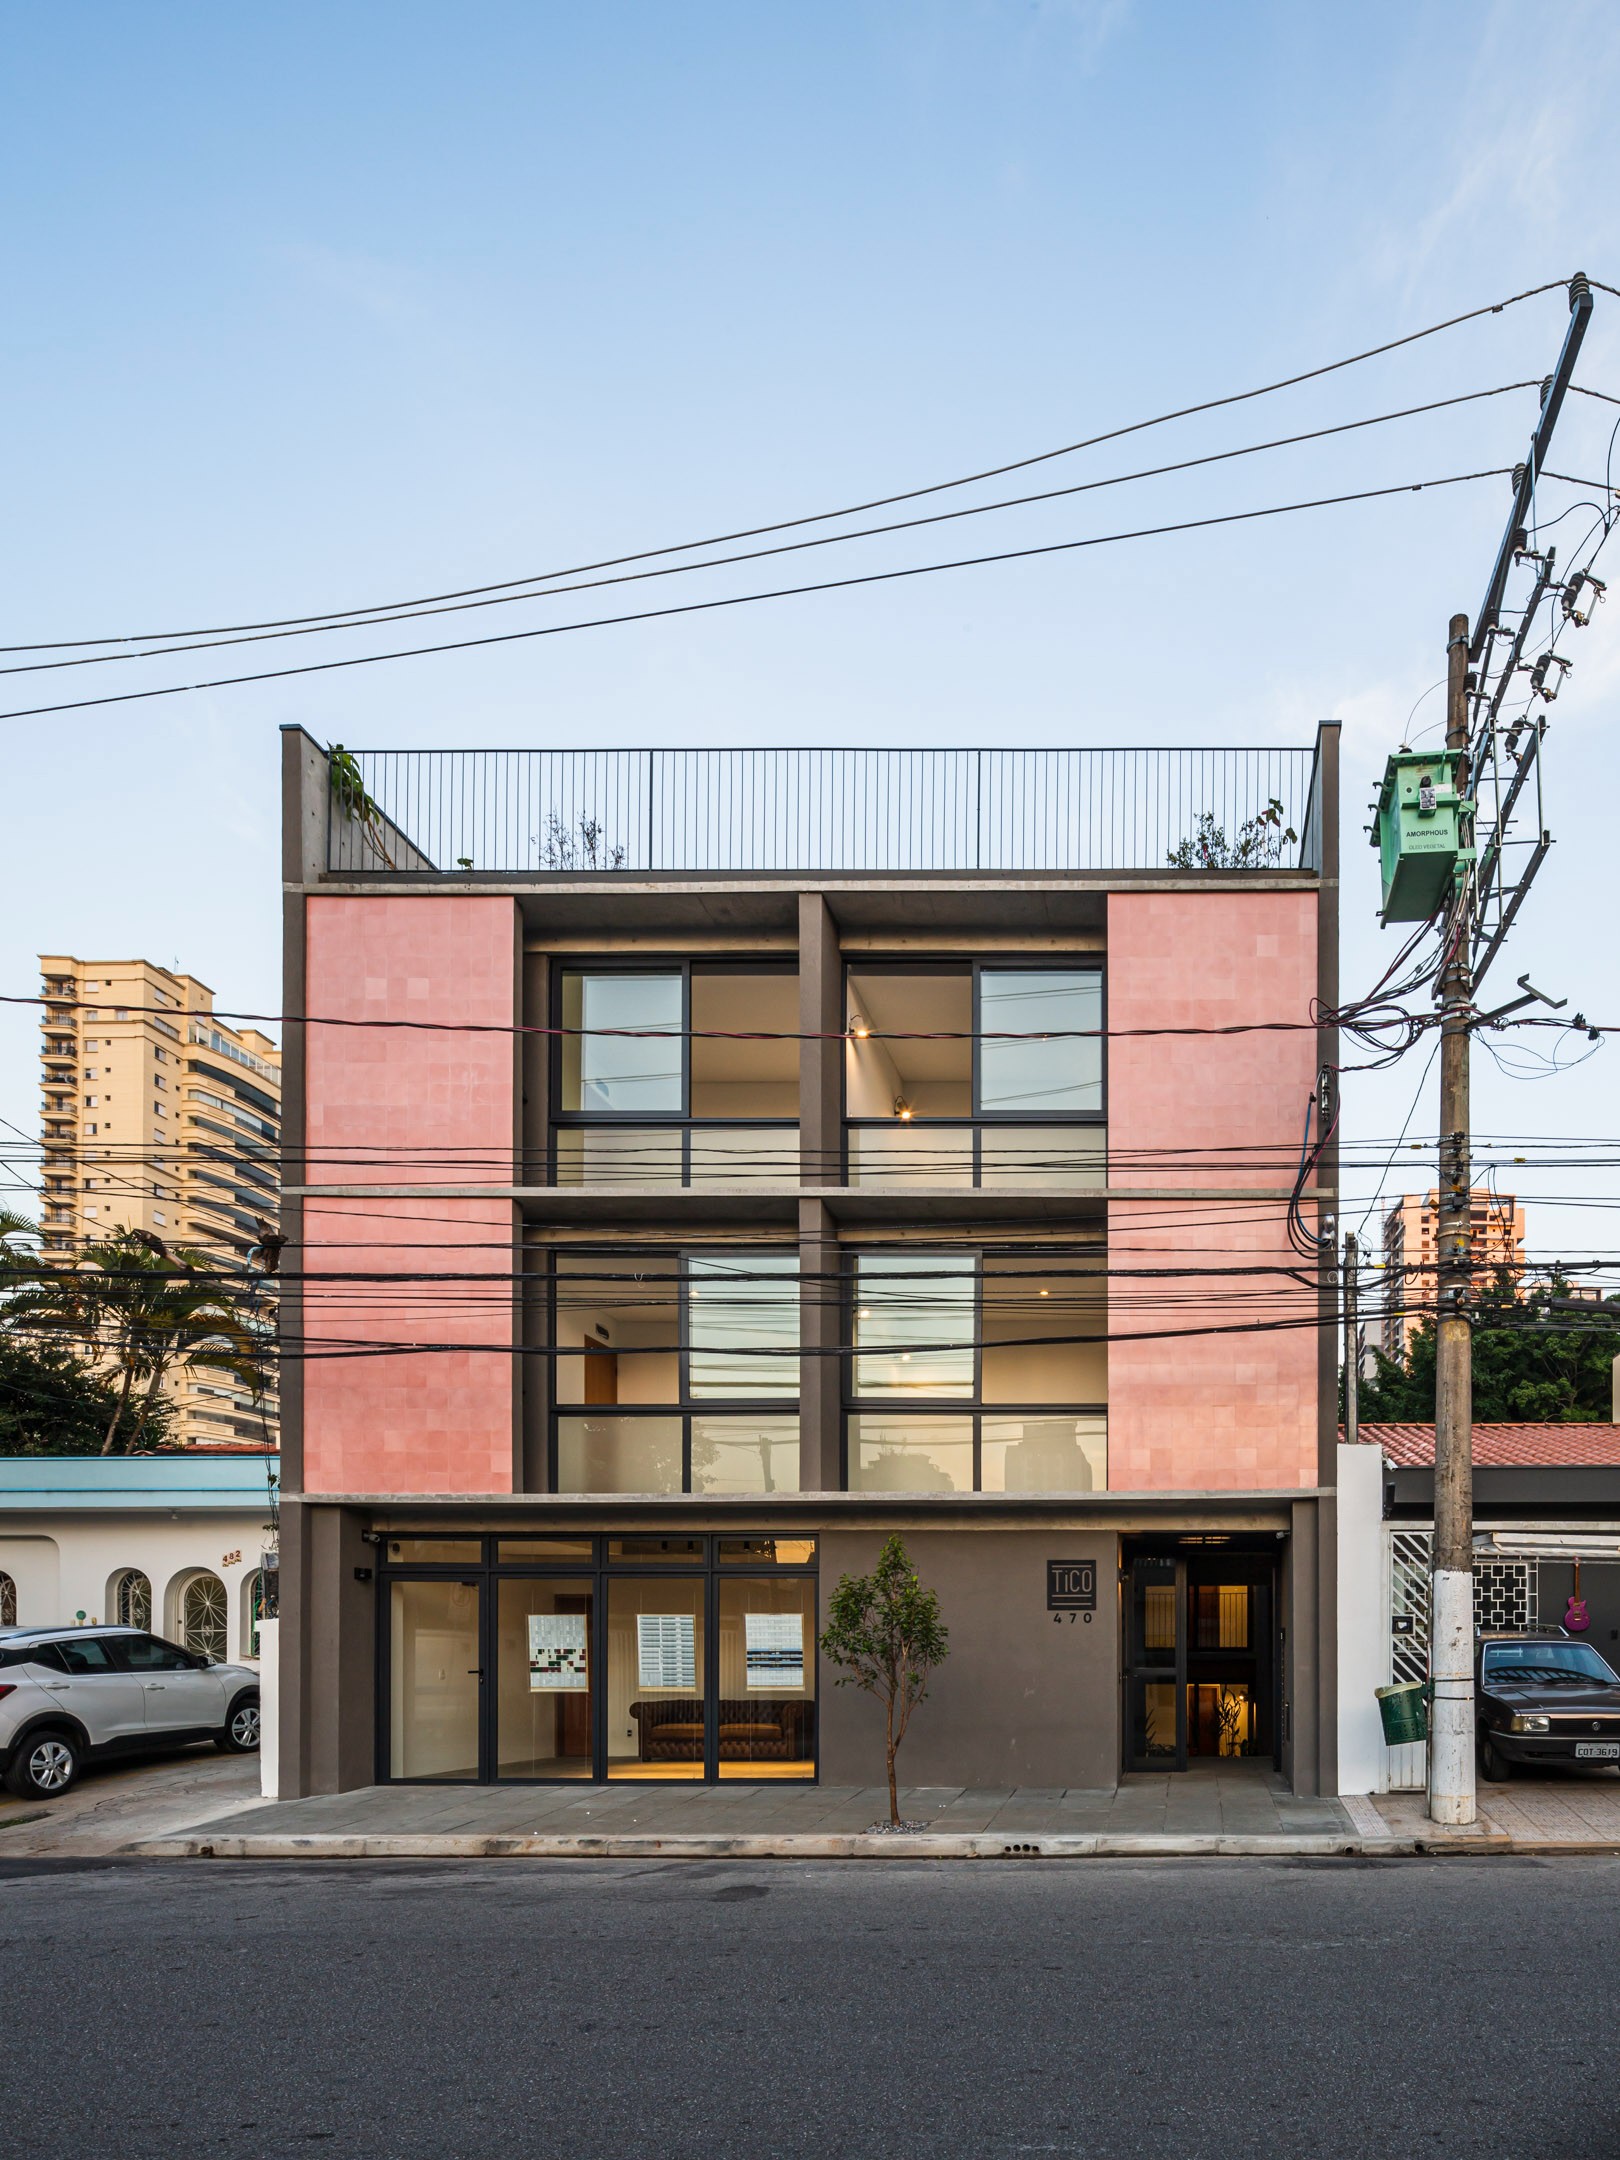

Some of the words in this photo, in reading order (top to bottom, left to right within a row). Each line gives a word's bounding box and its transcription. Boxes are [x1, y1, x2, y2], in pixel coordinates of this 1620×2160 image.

[1406, 829, 1449, 837] AMORPHOUS
[222, 1550, 241, 1563] 482
[1053, 1612, 1093, 1624] 470
